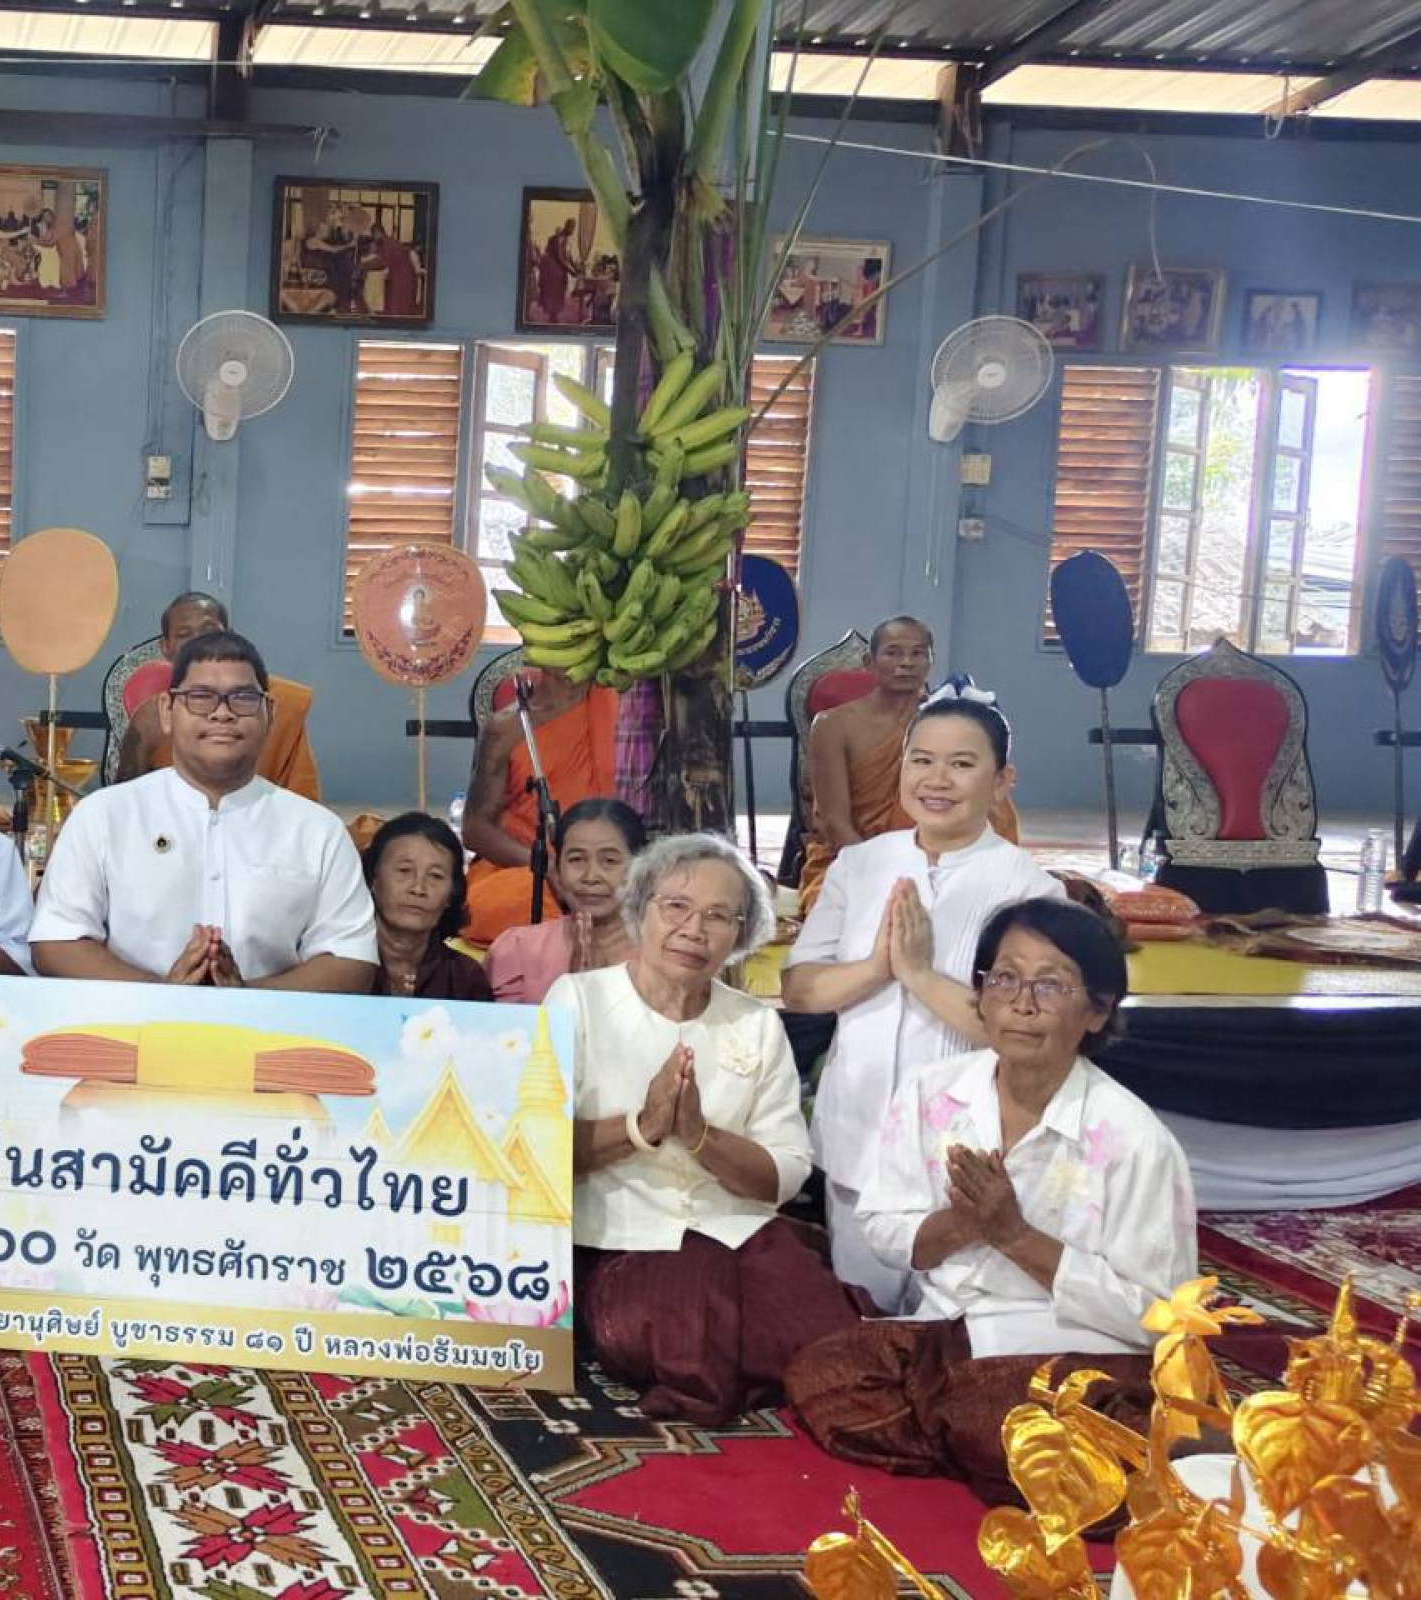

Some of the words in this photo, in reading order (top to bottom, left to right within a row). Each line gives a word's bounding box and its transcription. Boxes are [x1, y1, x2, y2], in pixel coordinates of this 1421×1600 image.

[74, 1227, 121, 1269] วัด
[135, 1238, 347, 1287] พุทธศักราช
[364, 1246, 551, 1302] ๒๕๖๘
[111, 1319, 234, 1348] บูชาธรรม
[245, 1331, 284, 1352] ๘๑
[294, 1326, 313, 1353] ปี
[325, 1334, 542, 1371] หลวงพ่อธัมมชโย
